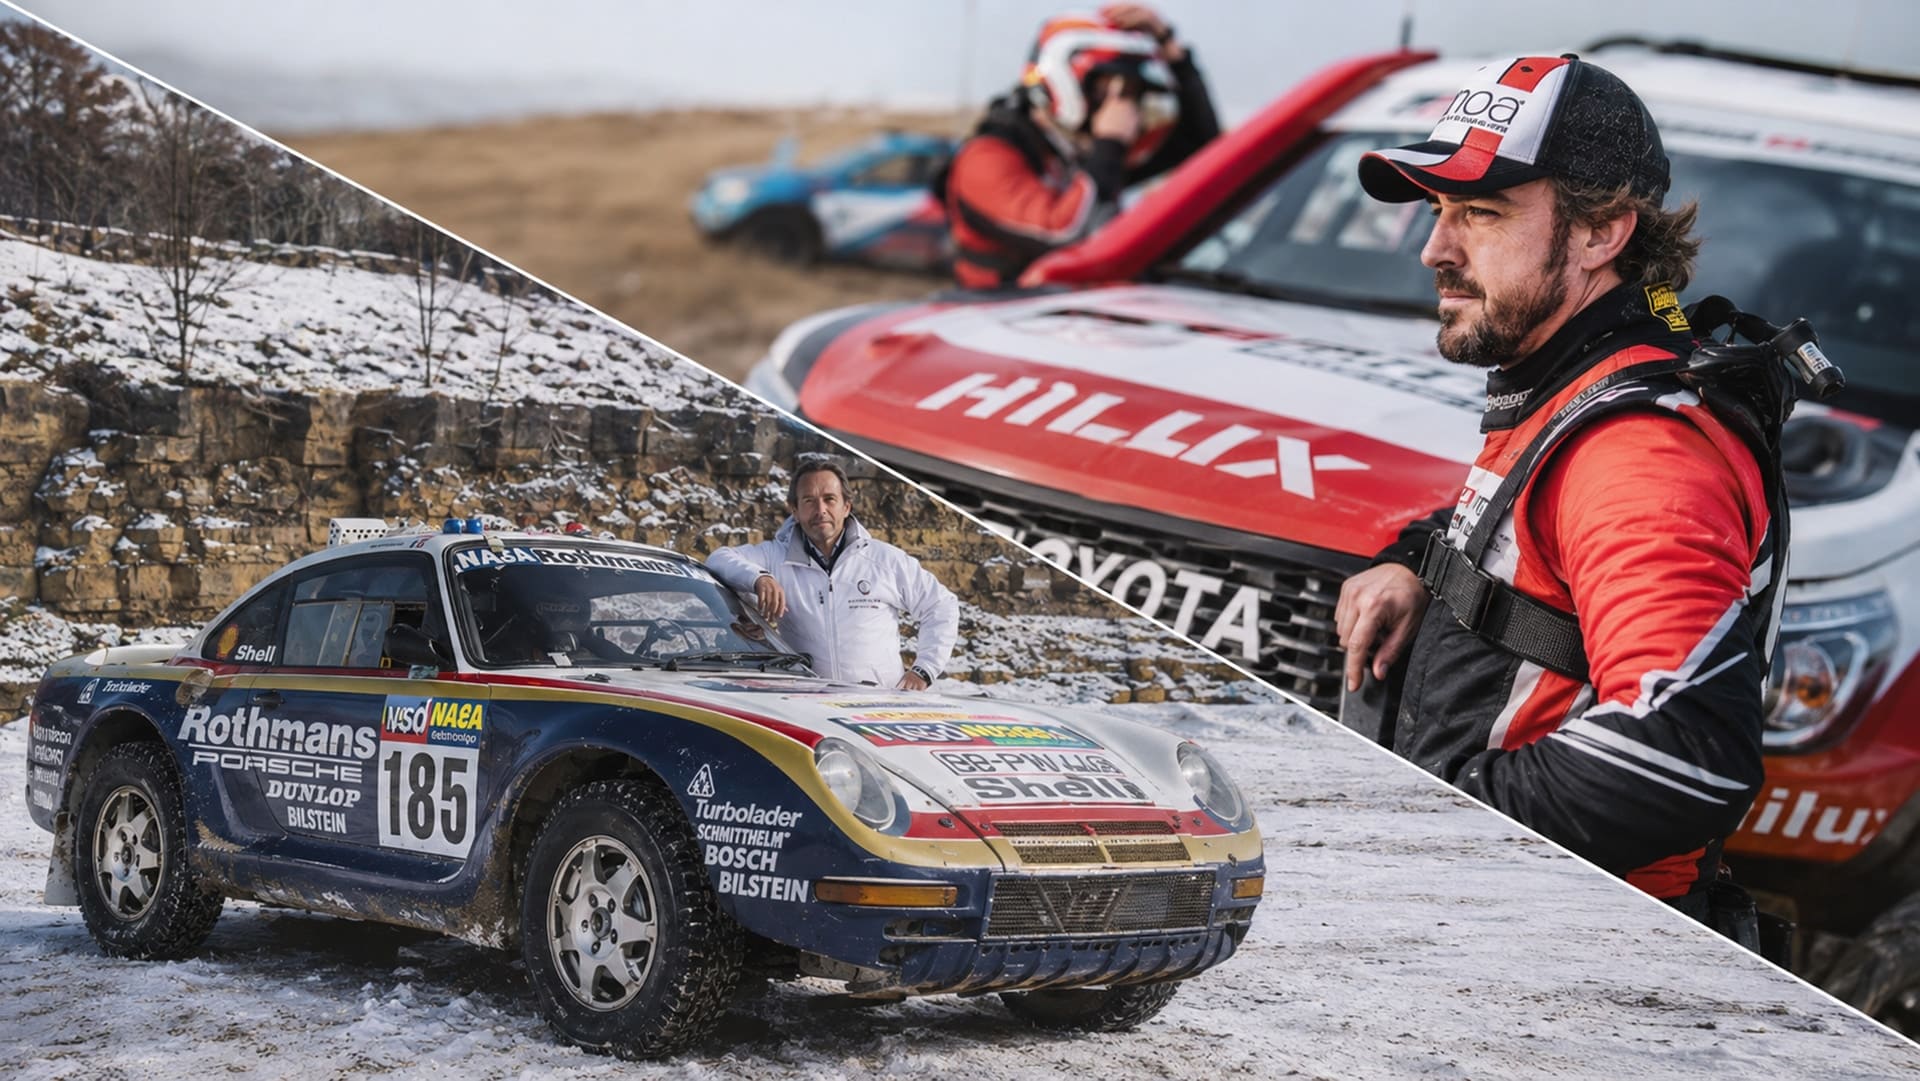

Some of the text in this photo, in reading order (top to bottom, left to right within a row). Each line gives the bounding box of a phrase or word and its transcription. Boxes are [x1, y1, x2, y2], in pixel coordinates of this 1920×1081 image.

[234, 645, 277, 663] Shell
[177, 703, 377, 759] Rothmans
[192, 751, 363, 783] PORSCHE
[266, 779, 362, 807] DUNLOP
[384, 750, 468, 845] 185
[287, 805, 347, 834] BILSTEIN
[695, 798, 803, 828] Turbolader
[1736, 788, 1887, 846] ilu
[697, 823, 784, 849] SCHMITTHELM
[704, 844, 778, 872] BOSCH
[718, 871, 809, 903] BILSTEIN
